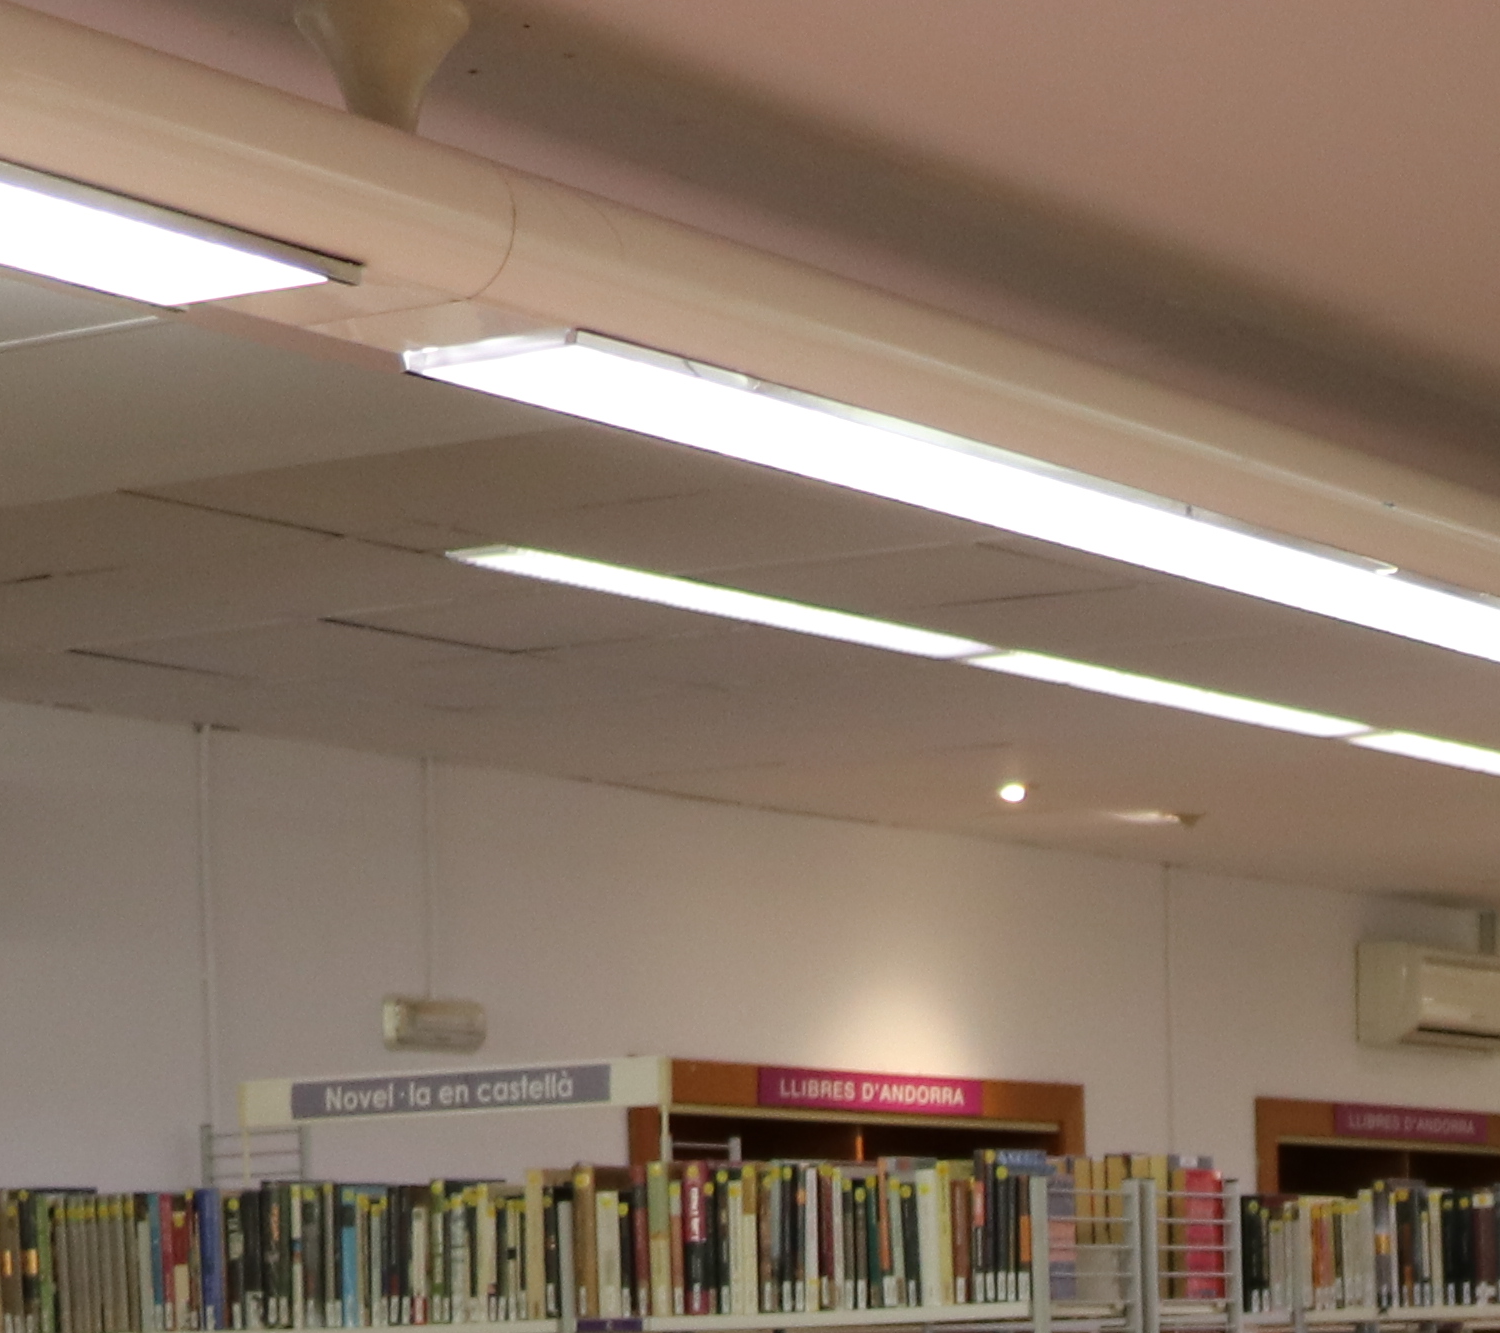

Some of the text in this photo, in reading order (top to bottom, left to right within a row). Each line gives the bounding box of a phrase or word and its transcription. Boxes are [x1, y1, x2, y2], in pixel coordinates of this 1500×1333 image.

[438, 1084, 470, 1104] en
[476, 1070, 574, 1103] castellà
[779, 1078, 965, 1106] LLIBRES D'ANDORRA
